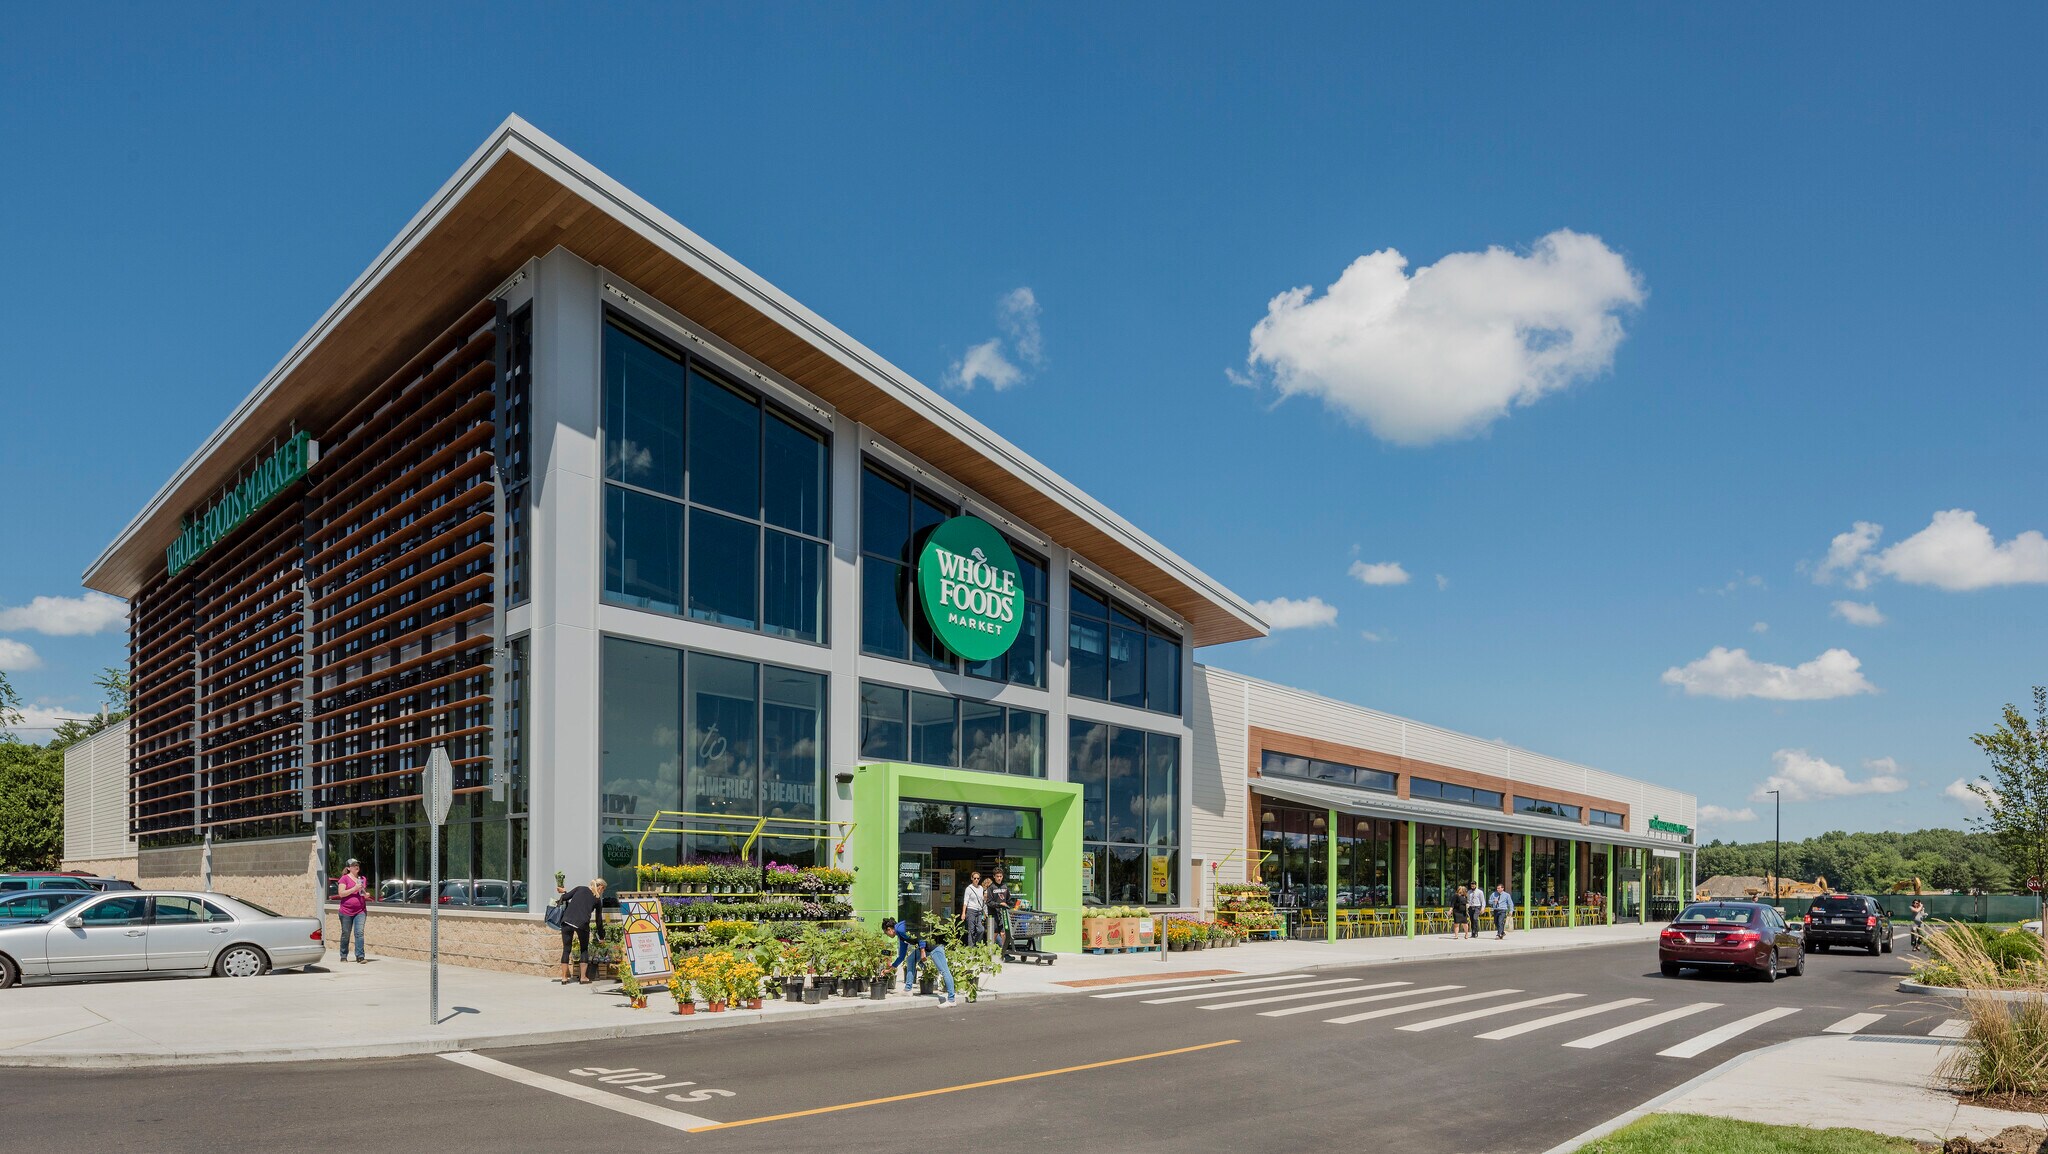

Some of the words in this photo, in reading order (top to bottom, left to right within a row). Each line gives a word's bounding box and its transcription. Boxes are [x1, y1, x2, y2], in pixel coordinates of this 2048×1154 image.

[166, 516, 203, 577] WHOLE
[202, 485, 245, 546] FOODS
[243, 431, 311, 518] MARKET
[935, 547, 1016, 597] WHOLE
[940, 578, 1014, 623] FOODS
[948, 612, 1003, 636] MARKET
[699, 723, 727, 761] to
[696, 775, 768, 801] AMERICAS
[568, 1067, 737, 1103] STOP
